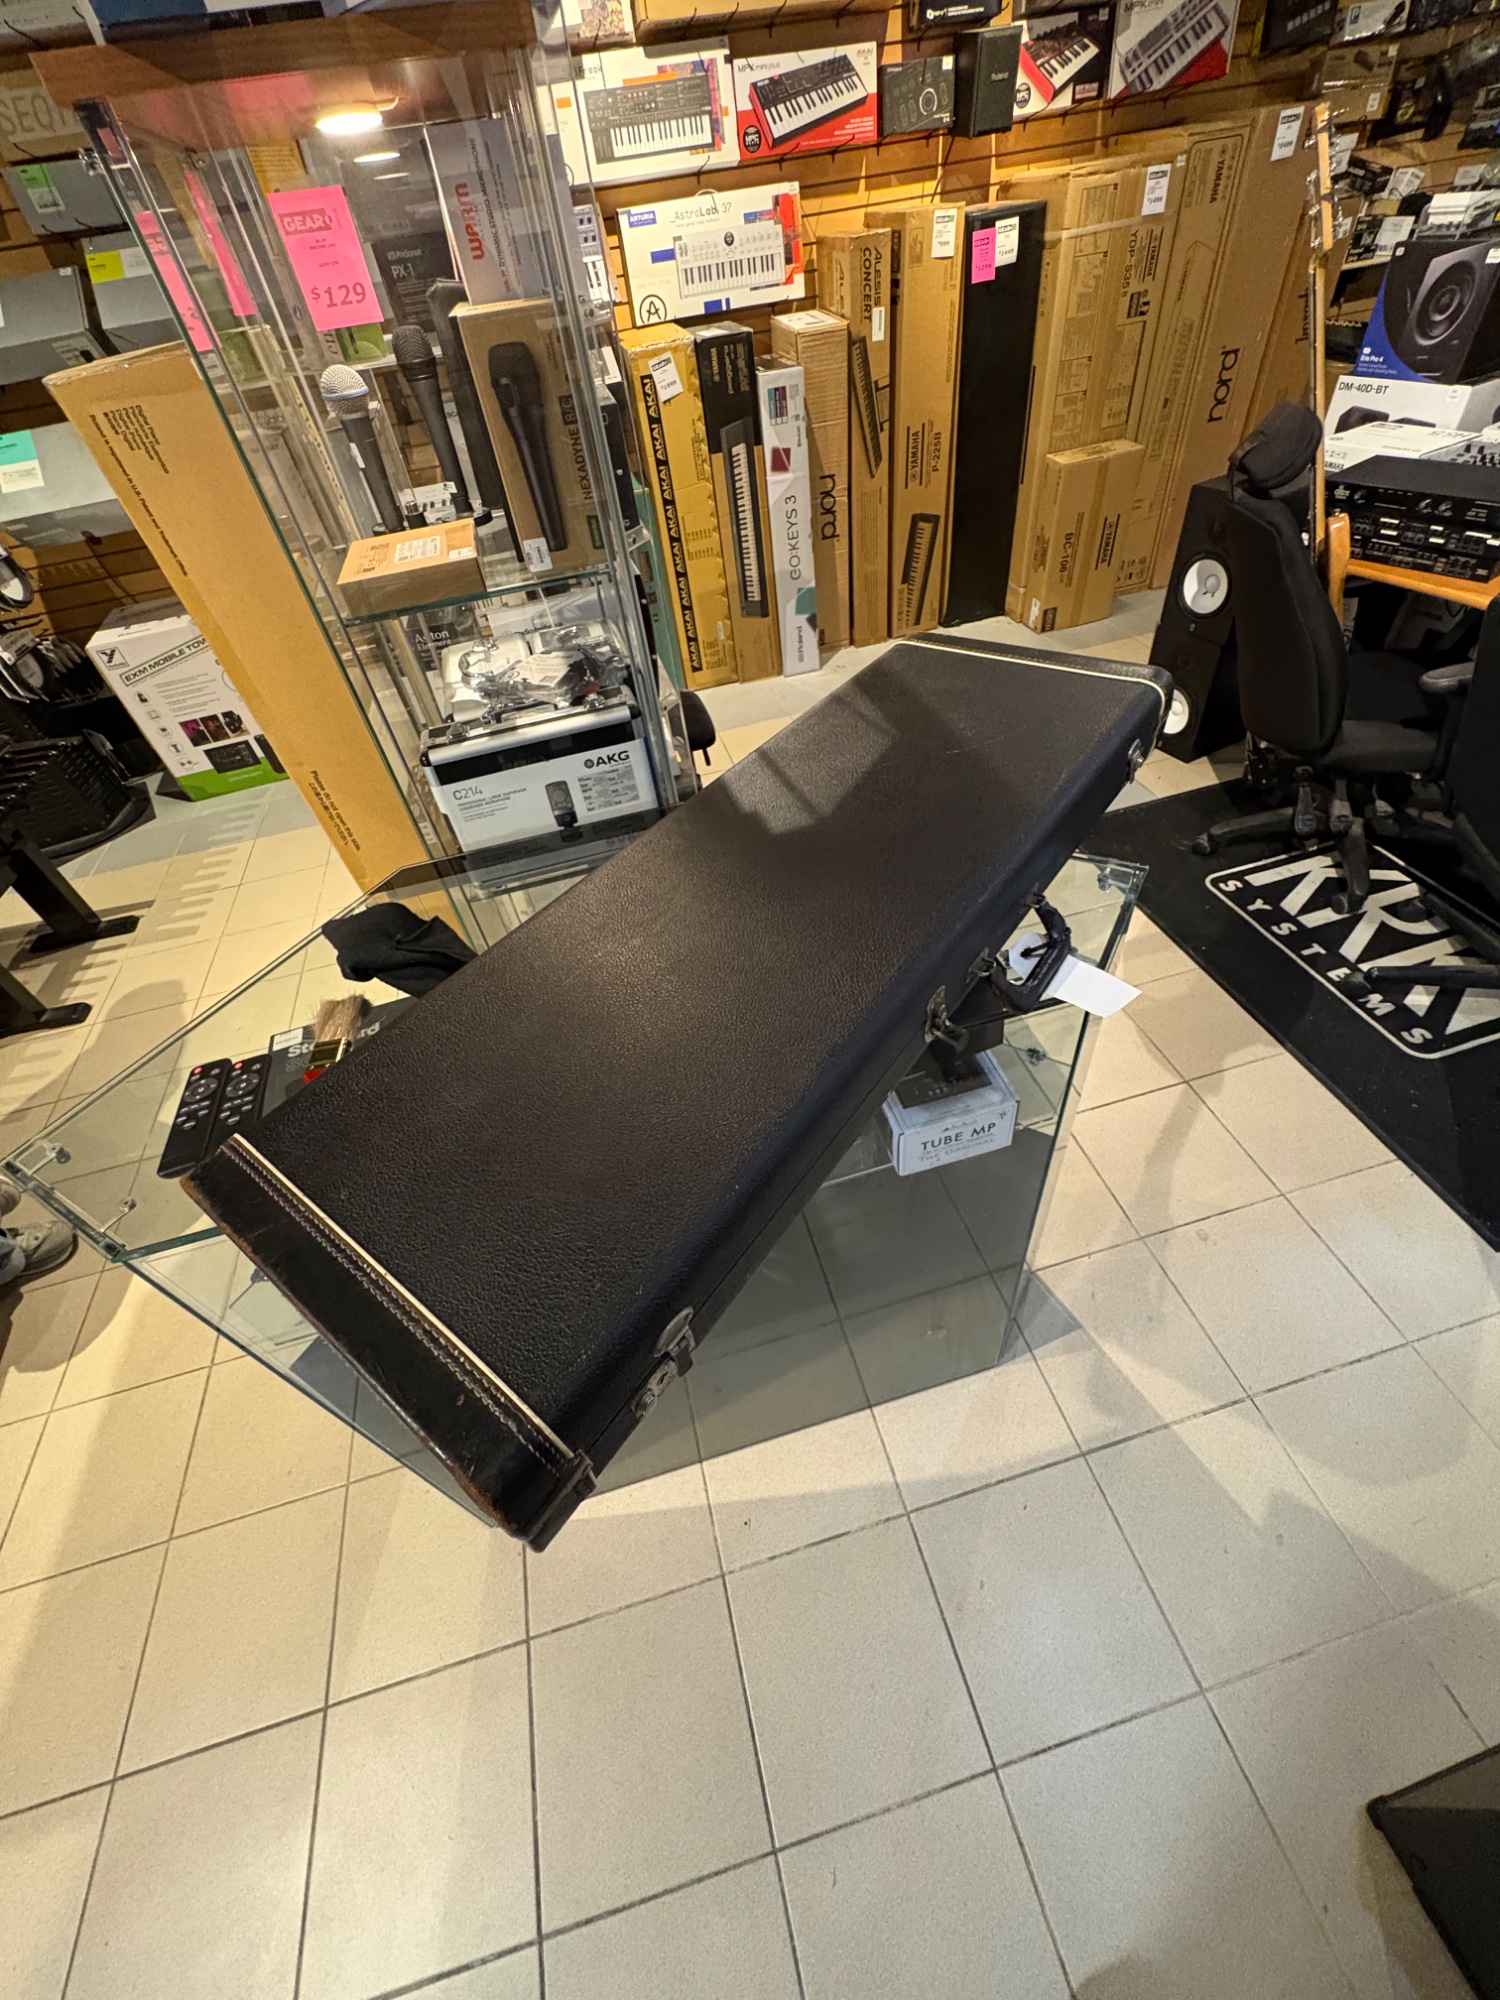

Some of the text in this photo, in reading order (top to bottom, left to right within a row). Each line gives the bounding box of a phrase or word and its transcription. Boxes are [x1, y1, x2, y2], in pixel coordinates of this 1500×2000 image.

[1209, 159, 1225, 204] YAMAHA
[283, 214, 324, 232] GEAR
[483, 199, 496, 229] STUDIO
[629, 213, 655, 223] ARTURIA
[721, 202, 732, 214] 37
[491, 230, 505, 267] DYNAMIC
[1146, 245, 1157, 277] YAMAHA
[391, 263, 414, 279] PX-1
[863, 247, 872, 322] CONCERT
[874, 246, 883, 307] ALESIS
[310, 282, 367, 309] $129
[710, 347, 719, 376] YAMAHA
[643, 379, 659, 418] AKAI
[1207, 347, 1240, 423] nord
[1338, 382, 1389, 395] DM-40D-BT
[651, 424, 666, 460] AKAI
[910, 430, 920, 471] YAMAHA
[932, 431, 942, 473] P-225B
[568, 427, 593, 500] NEXADYNE
[1323, 460, 1344, 471] AMAHA
[657, 467, 674, 500] AKAI
[785, 495, 797, 504] 3
[139, 498, 154, 518] Patent
[151, 518, 160, 529] and
[665, 505, 679, 537] AKAI
[819, 473, 839, 541] nord
[671, 543, 687, 573] AKAI
[1058, 532, 1074, 575] BC-108
[1100, 532, 1113, 564] YAMAHA
[677, 578, 692, 606] AKAI
[683, 611, 696, 638] AKAI
[124, 665, 149, 683] EXM
[148, 648, 186, 673] MOBILE
[187, 637, 208, 654] TOW
[689, 642, 701, 668] AKAI
[595, 750, 630, 768] AKG
[310, 770, 326, 791] Please
[327, 800, 338, 811] not
[333, 811, 347, 827] open
[343, 827, 353, 838] this
[453, 785, 483, 801] C214
[1218, 880, 1434, 1044] SYSTEMS
[921, 1127, 964, 1152] TUBE
[970, 1121, 996, 1140] MP
